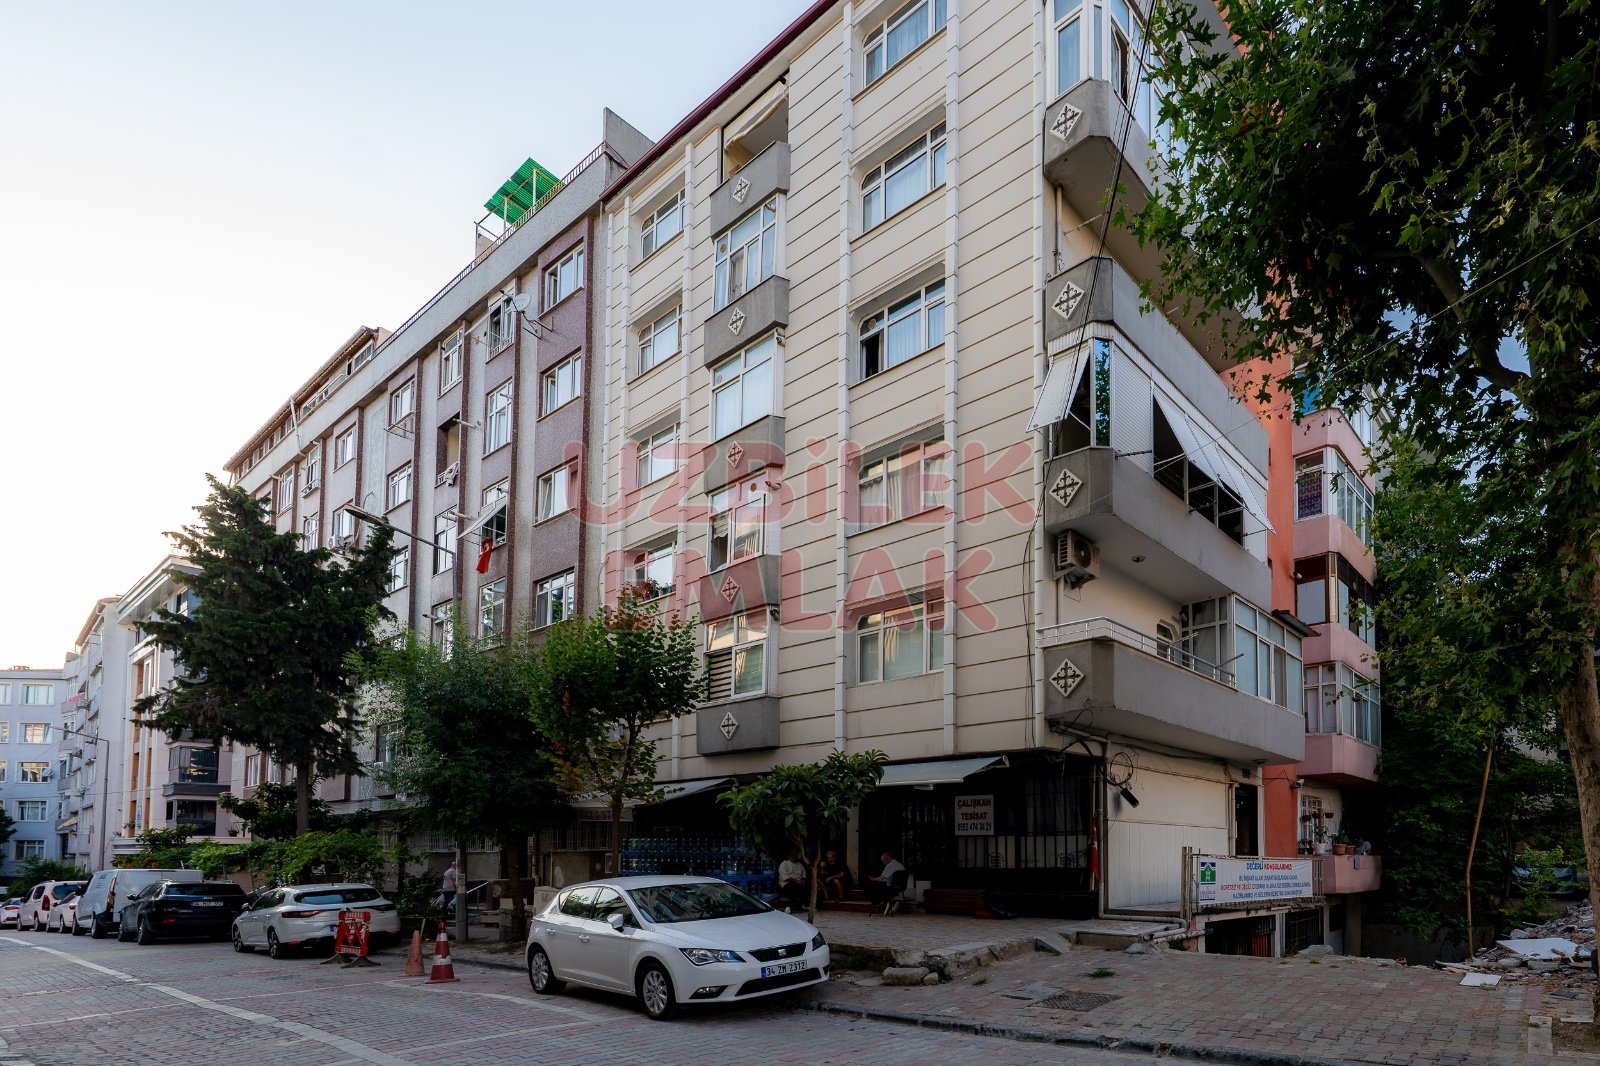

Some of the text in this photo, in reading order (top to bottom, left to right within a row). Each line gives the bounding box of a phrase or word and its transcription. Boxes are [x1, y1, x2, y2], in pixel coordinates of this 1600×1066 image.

[957, 798, 992, 809] ÇALIŞKAN
[960, 810, 988, 821] TESİSAT
[766, 968, 776, 976] 34
[789, 961, 805, 972] 2312
